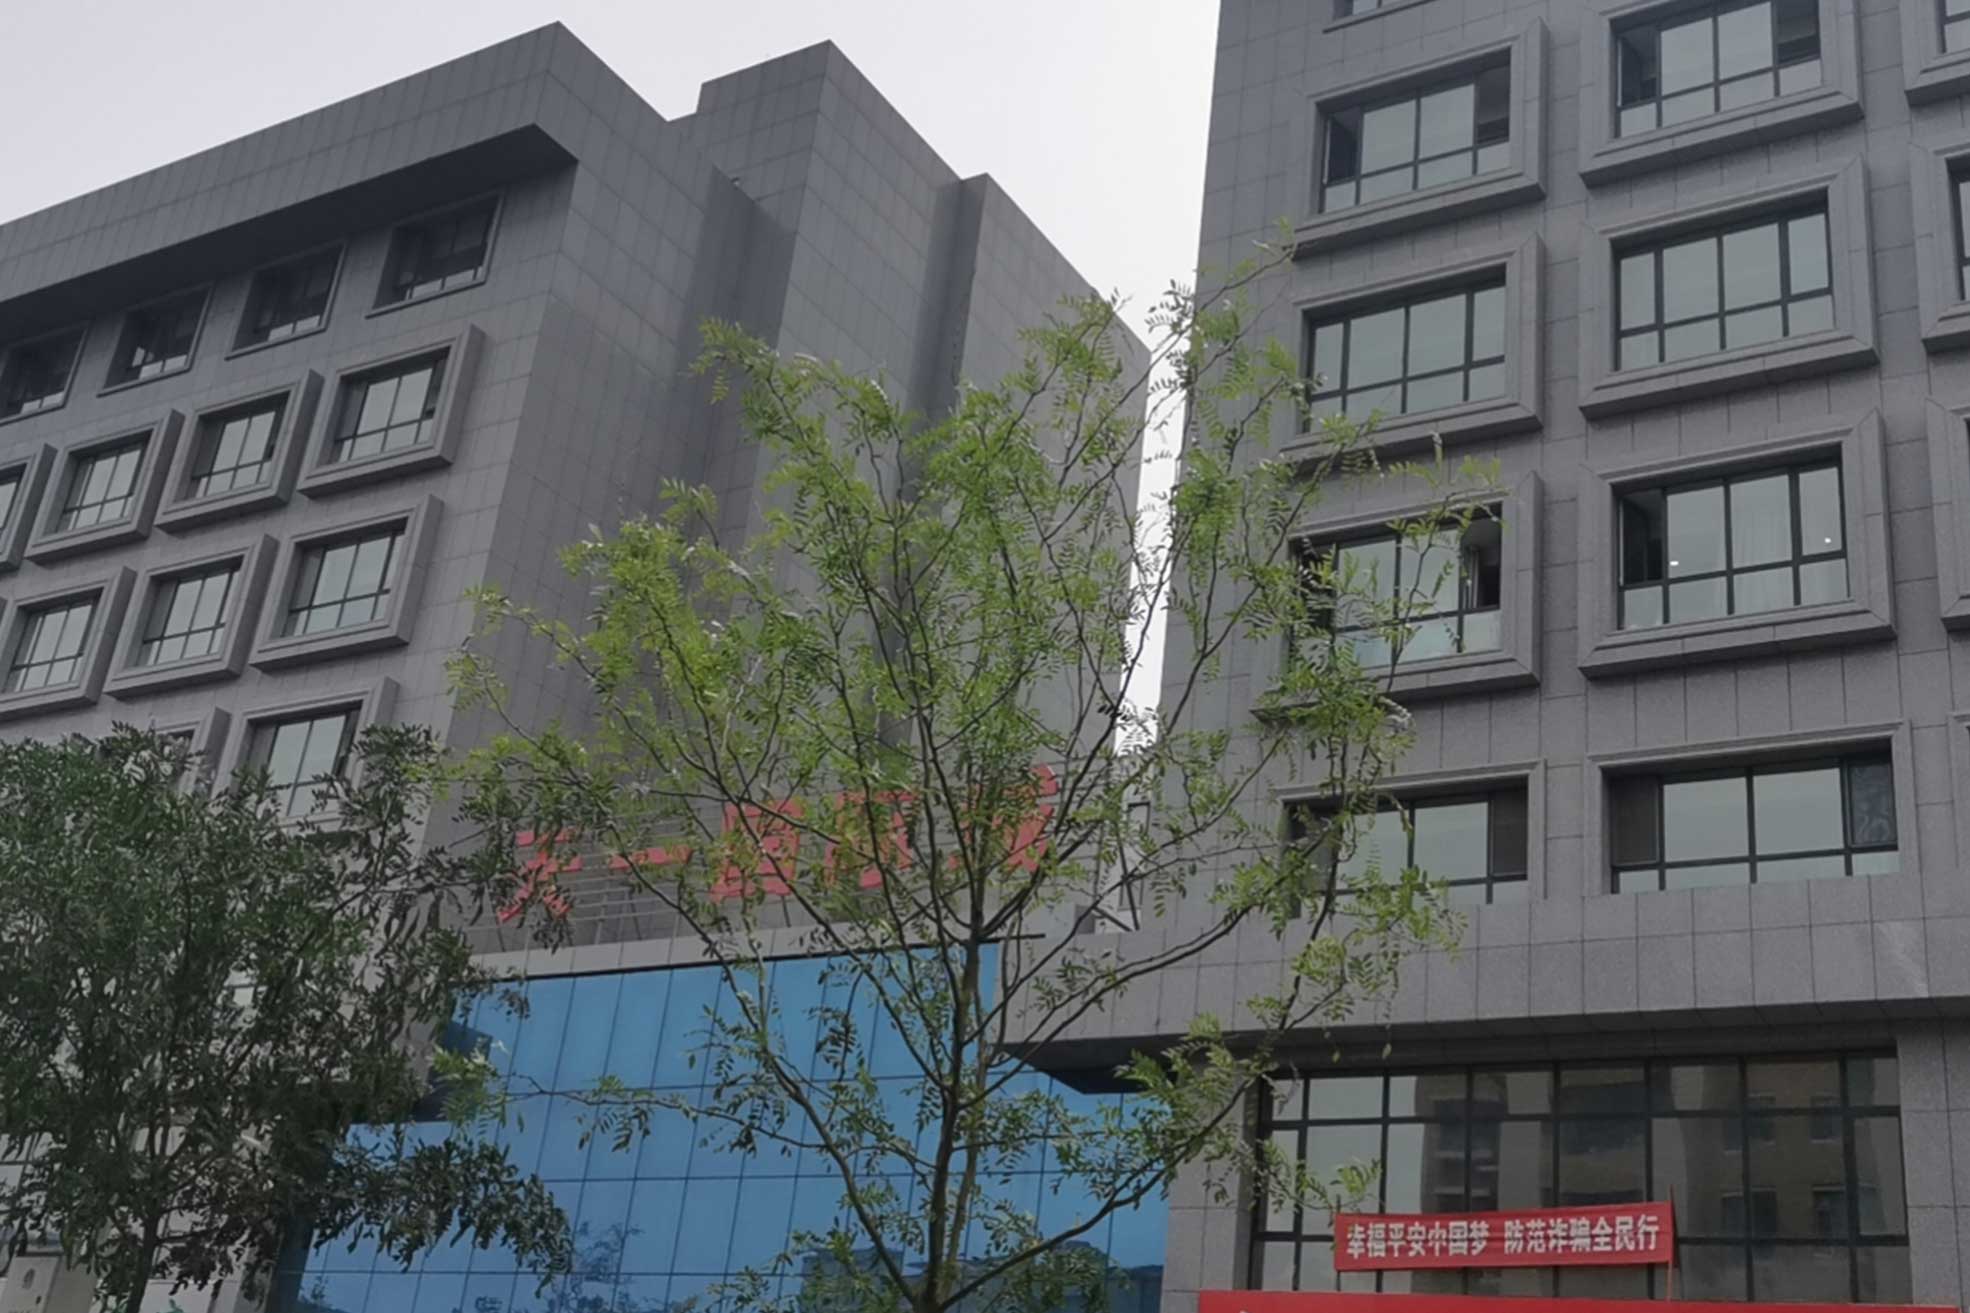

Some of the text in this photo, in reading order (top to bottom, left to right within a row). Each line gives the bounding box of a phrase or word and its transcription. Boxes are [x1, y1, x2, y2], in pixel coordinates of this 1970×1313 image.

[1346, 1213, 1660, 1260] 幸福平安中国梦 防范诈骗全民行
